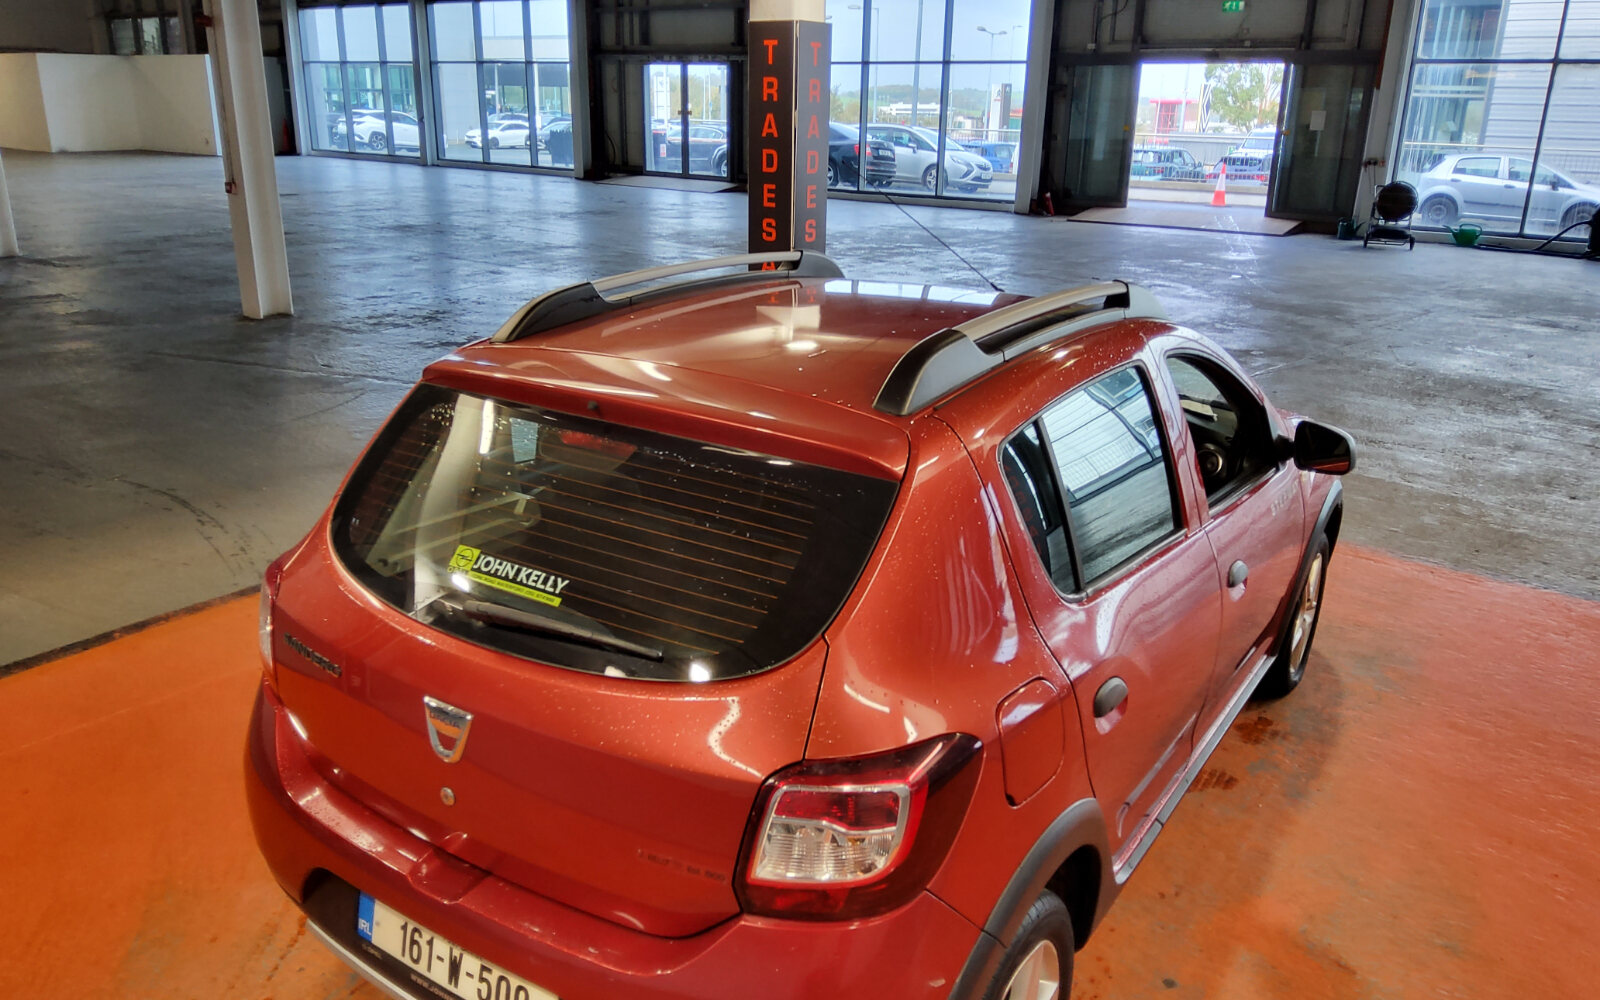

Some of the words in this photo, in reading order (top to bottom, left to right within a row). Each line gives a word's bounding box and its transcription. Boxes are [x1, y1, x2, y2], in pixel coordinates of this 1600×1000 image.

[472, 553, 519, 580] JOHN
[516, 566, 570, 594] KELLY
[358, 917, 372, 937] IRL
